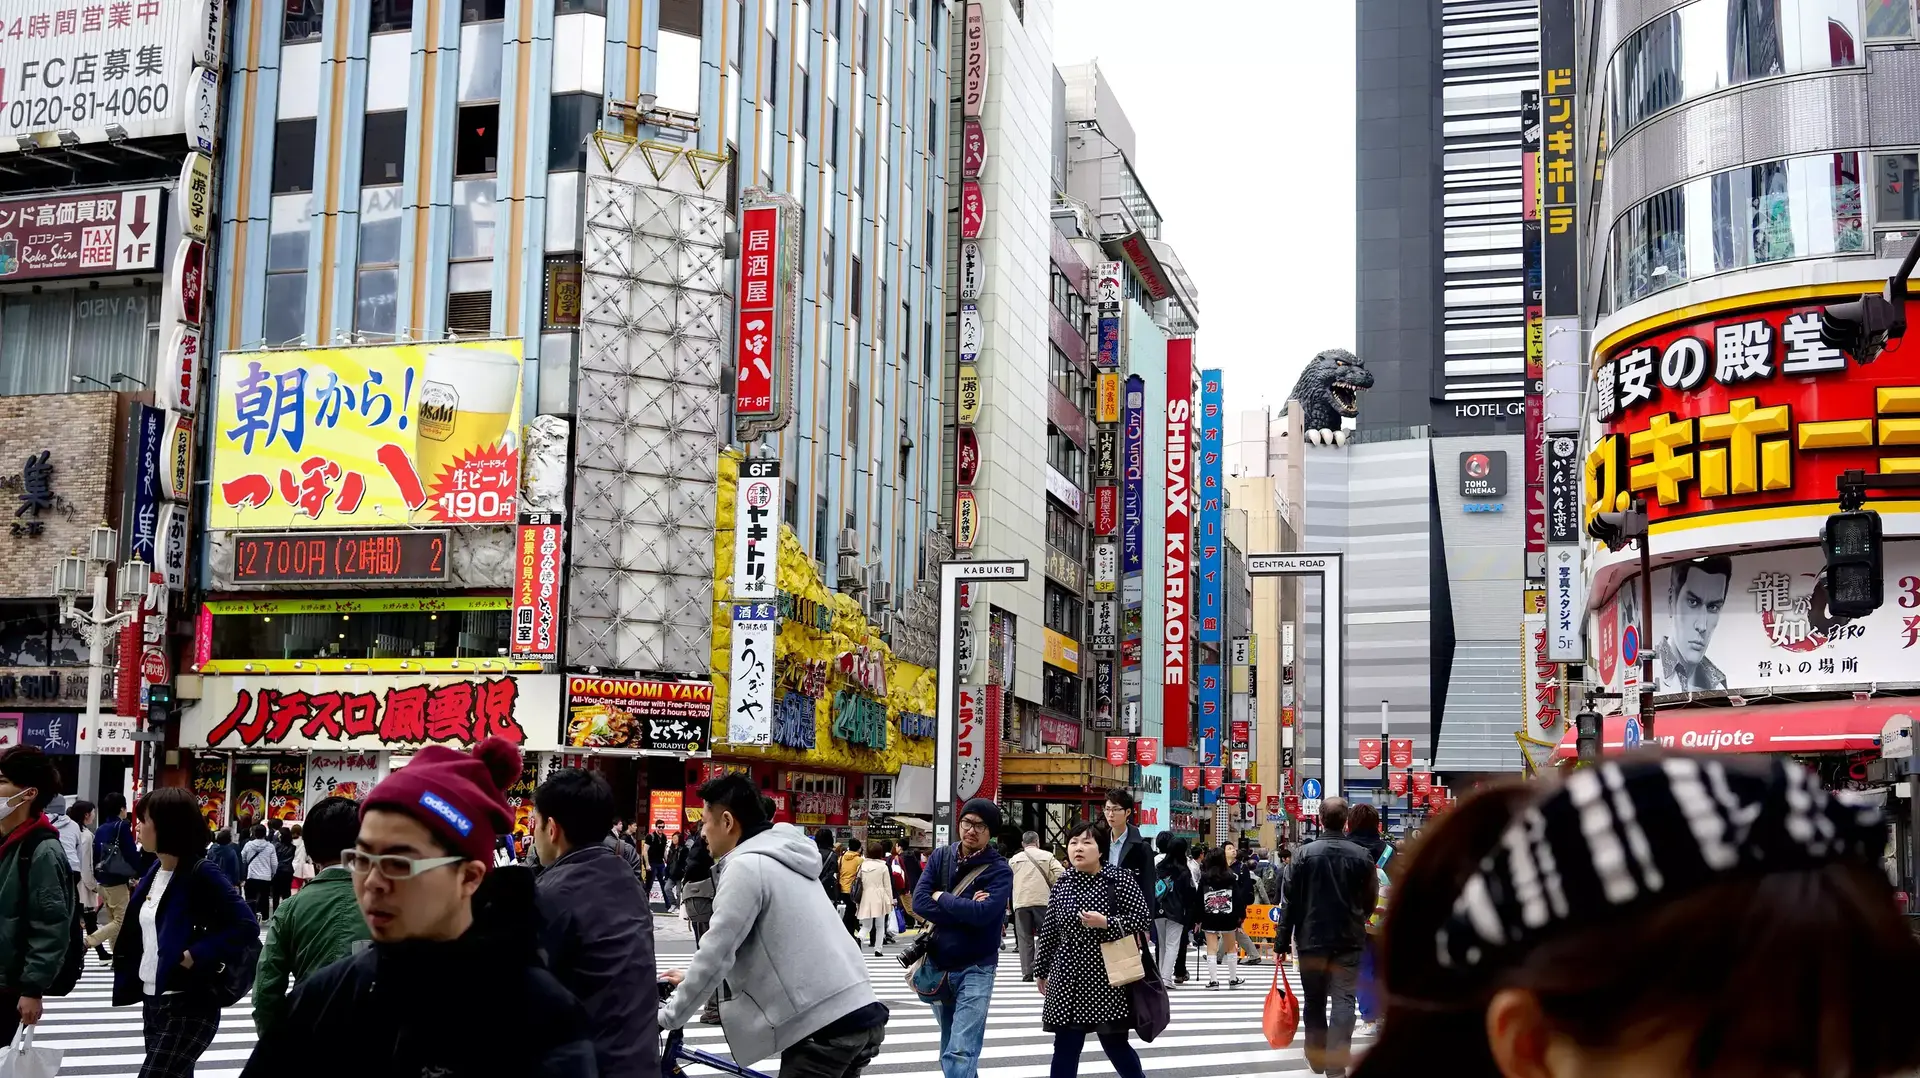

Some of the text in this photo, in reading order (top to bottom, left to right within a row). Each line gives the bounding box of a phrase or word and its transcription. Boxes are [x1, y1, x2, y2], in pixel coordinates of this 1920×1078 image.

[0, 1, 160, 42] 4時間営業中
[20, 44, 164, 91] FC店募集
[204, 50, 217, 64] 6F
[10, 83, 169, 129] 0120-81-4060
[200, 141, 209, 150] 5F
[966, 134, 982, 163] つぼ八
[191, 178, 206, 219] 虎の子
[964, 194, 981, 225] つぼ八
[28, 231, 73, 246] ロコシーラ
[84, 229, 113, 247] TAX
[22, 243, 79, 264] Roko Shira
[82, 246, 112, 264] FREE
[123, 243, 151, 263] 1F
[746, 229, 770, 303] 居酒屋
[962, 289, 976, 299] 6F
[739, 319, 771, 381] つぼ八
[1596, 312, 1846, 421] 驚安の殿堂
[962, 381, 977, 410] 虎の子
[226, 361, 414, 455] 朝から!
[420, 400, 454, 424] Asahi
[1455, 403, 1504, 417] HOTEL
[177, 432, 188, 490] お好み焼き
[1100, 432, 1113, 471] 山内農場
[465, 459, 507, 468] スーパードライ
[749, 463, 773, 477] 6F
[222, 444, 427, 520] つぼ八
[452, 468, 512, 491] 生ビール
[1465, 480, 1488, 488] TOHO
[1465, 487, 1497, 495] CINEMAS
[444, 491, 512, 518] 190円
[759, 486, 768, 504] 東京
[1203, 381, 1218, 631] カラオケ&パーティー館
[1552, 458, 1567, 537] かんかん商店
[1463, 503, 1504, 512] IMAX
[530, 515, 551, 524] 2階
[962, 500, 971, 541] お好み焼き
[1125, 491, 1140, 553] SHINJUKU
[170, 522, 184, 570] かっぱ
[746, 505, 769, 580] ヤキトリ
[1165, 400, 1189, 685] SHIDAX KARAOKE
[539, 527, 557, 598] お好み焼き
[1252, 560, 1326, 568] CENTRAL ROAD
[170, 573, 180, 584] B1
[517, 529, 536, 641] 夜景の見える 個室
[745, 582, 764, 591] 本舗
[1099, 582, 1111, 591] 3F
[1558, 566, 1571, 631] 写真スタジオ
[1749, 571, 1812, 615] 龍が
[738, 605, 769, 619] 酒処
[1558, 635, 1574, 649] 5F
[1767, 613, 1825, 648] 如く
[1828, 624, 1866, 643] ZERO
[146, 663, 164, 677] 消火栓
[1758, 656, 1859, 678] 誓いの場所
[571, 678, 712, 701] OKONOMI YAKI
[737, 638, 765, 721] うさぎや
[205, 676, 529, 747] パチスロ風雲児
[571, 695, 627, 706] All-You-Can-Eat
[667, 701, 710, 711] Free-Flowing
[626, 706, 649, 715] Drinks
[667, 708, 687, 717] hours
[688, 710, 710, 718] ¥2,700
[975, 687, 984, 726] 大衆酒場
[958, 691, 974, 757] トラノコ
[1202, 677, 1217, 764] カラオケ
[652, 742, 698, 750] TORADYU 2F
[756, 733, 769, 742] 5F
[1232, 741, 1248, 749] Cafe
[1626, 727, 1635, 743] P
[1681, 729, 1755, 751] Quijote
[313, 776, 338, 791] 全台
[424, 796, 458, 822] adidas
[871, 803, 893, 811] 虎の子
